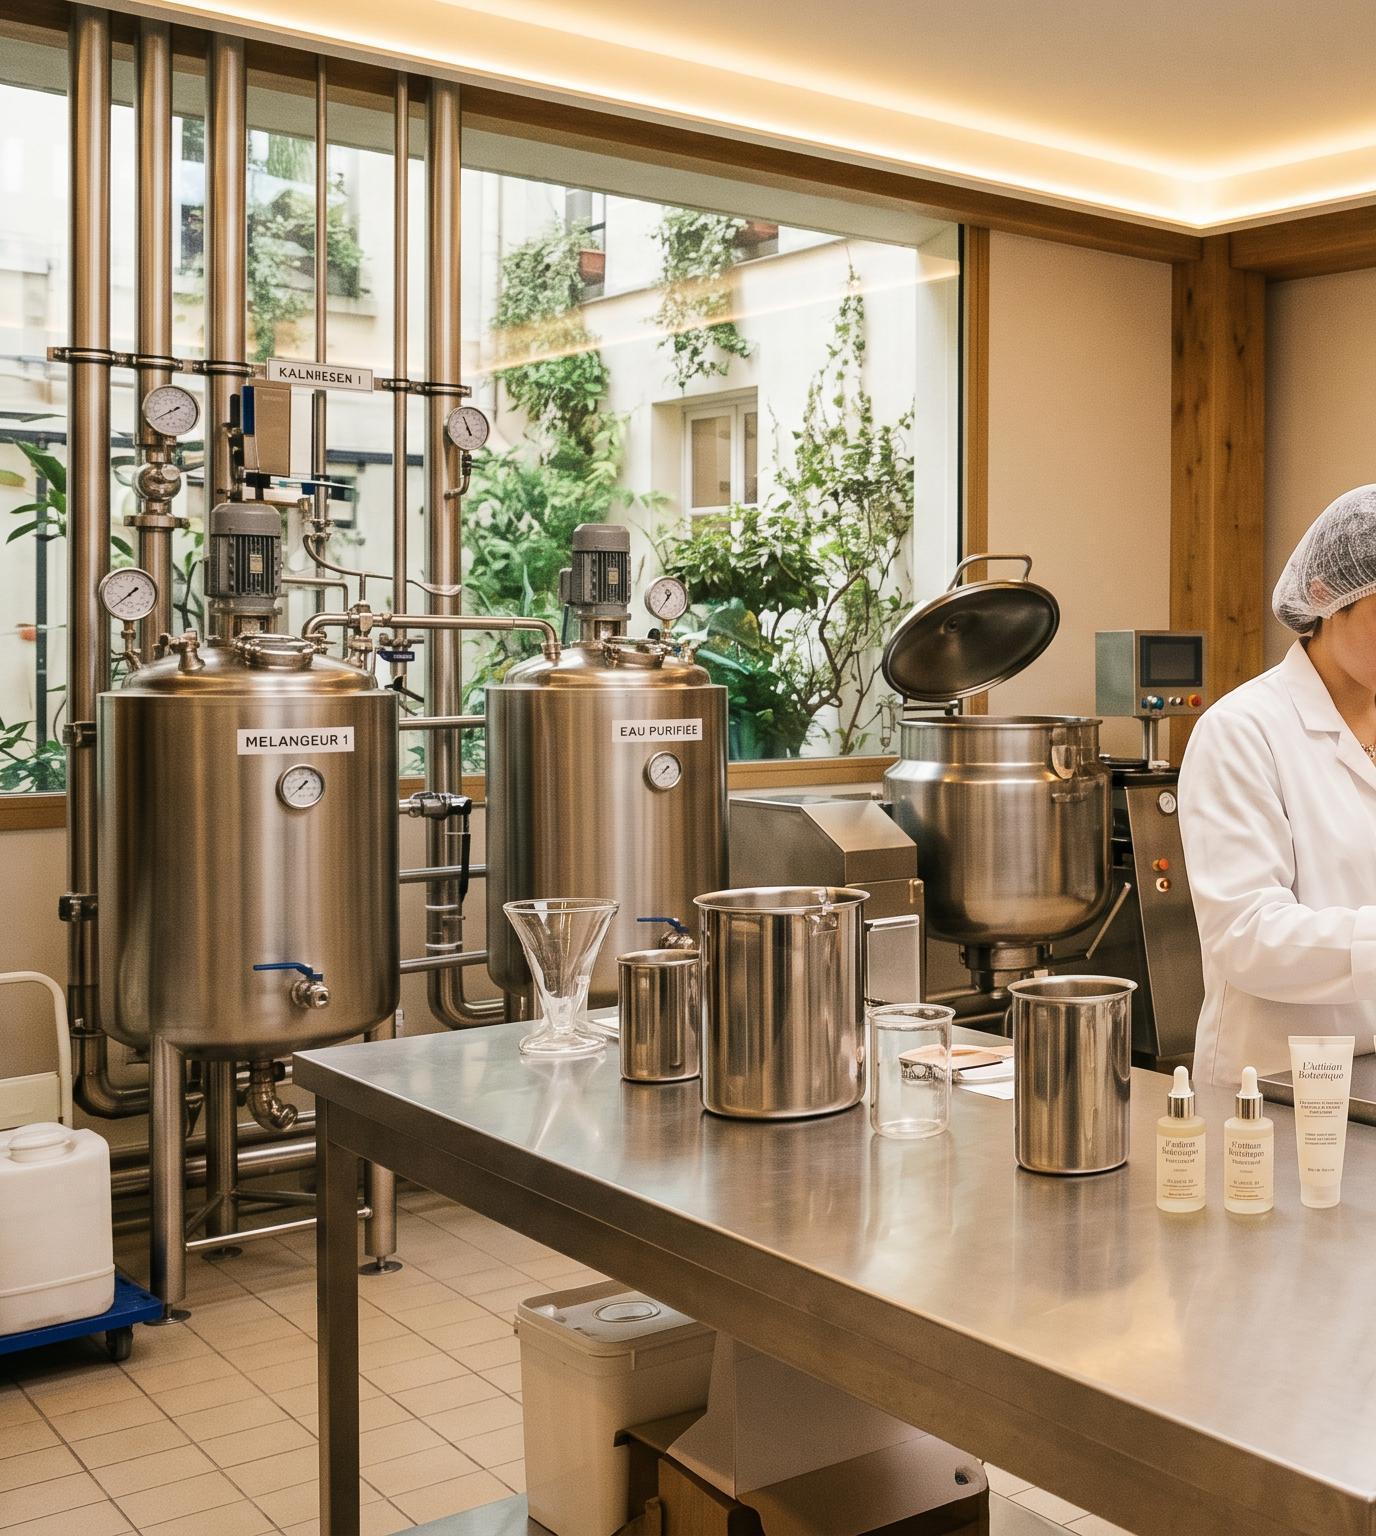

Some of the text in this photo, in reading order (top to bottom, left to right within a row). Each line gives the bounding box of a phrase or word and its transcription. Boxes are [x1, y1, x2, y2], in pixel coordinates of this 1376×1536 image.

[620, 726, 645, 737] EAU
[245, 734, 348, 748] MELANGEUR 1
